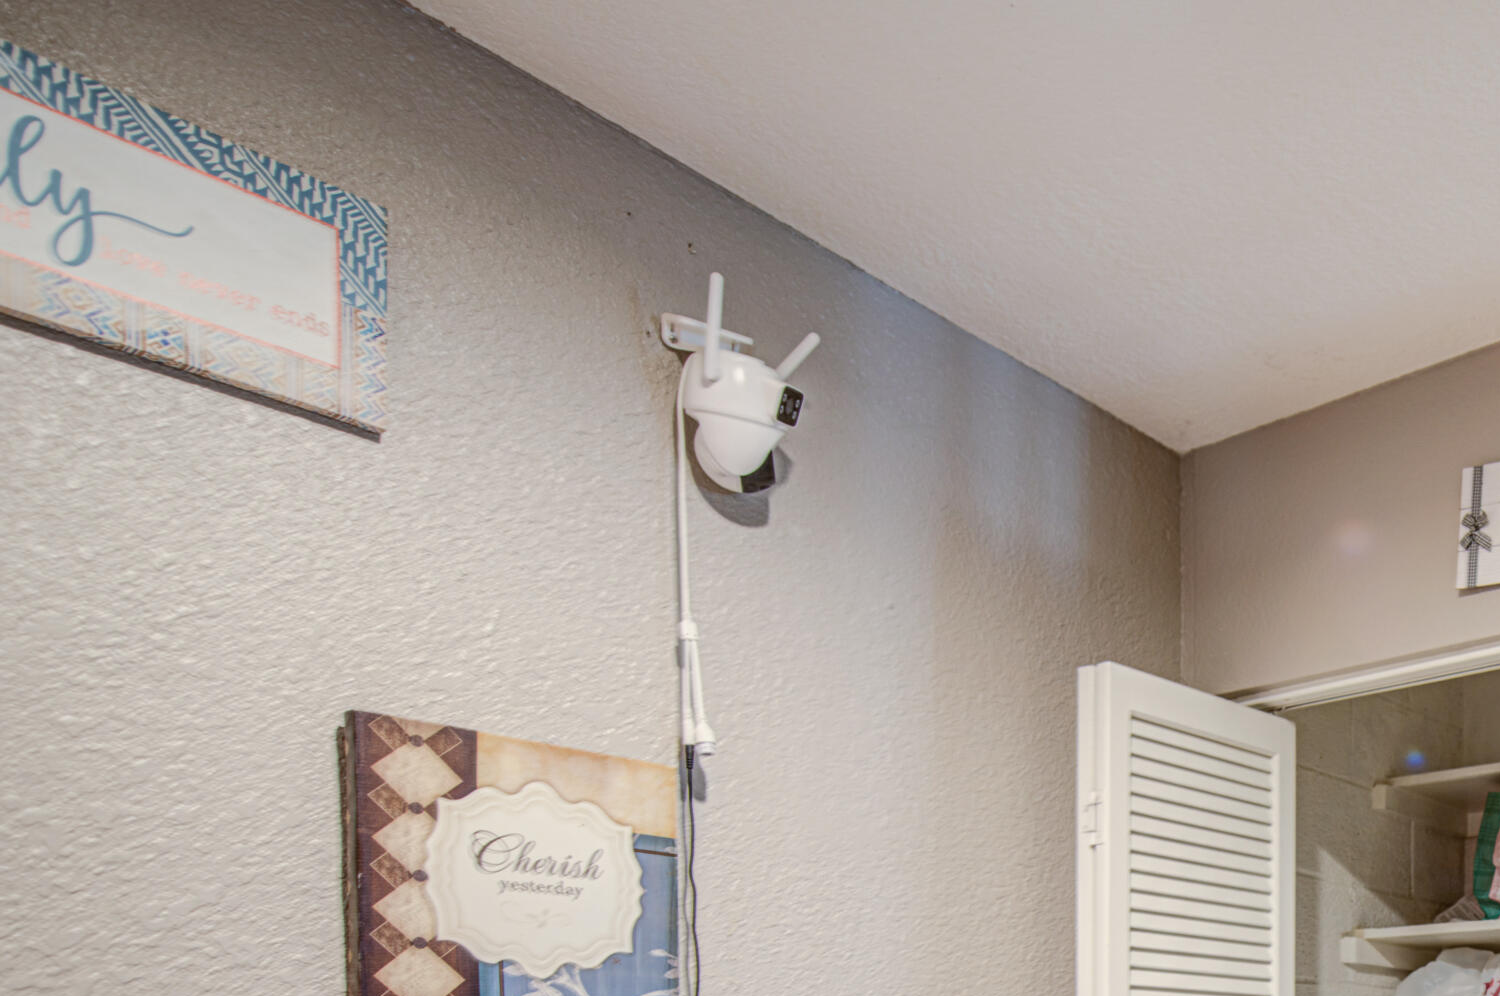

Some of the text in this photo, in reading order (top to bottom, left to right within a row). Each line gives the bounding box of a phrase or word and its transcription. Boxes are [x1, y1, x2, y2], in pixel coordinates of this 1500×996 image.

[0, 115, 194, 267] ly
[471, 830, 604, 882] Cherish
[498, 877, 584, 899] yesterday
